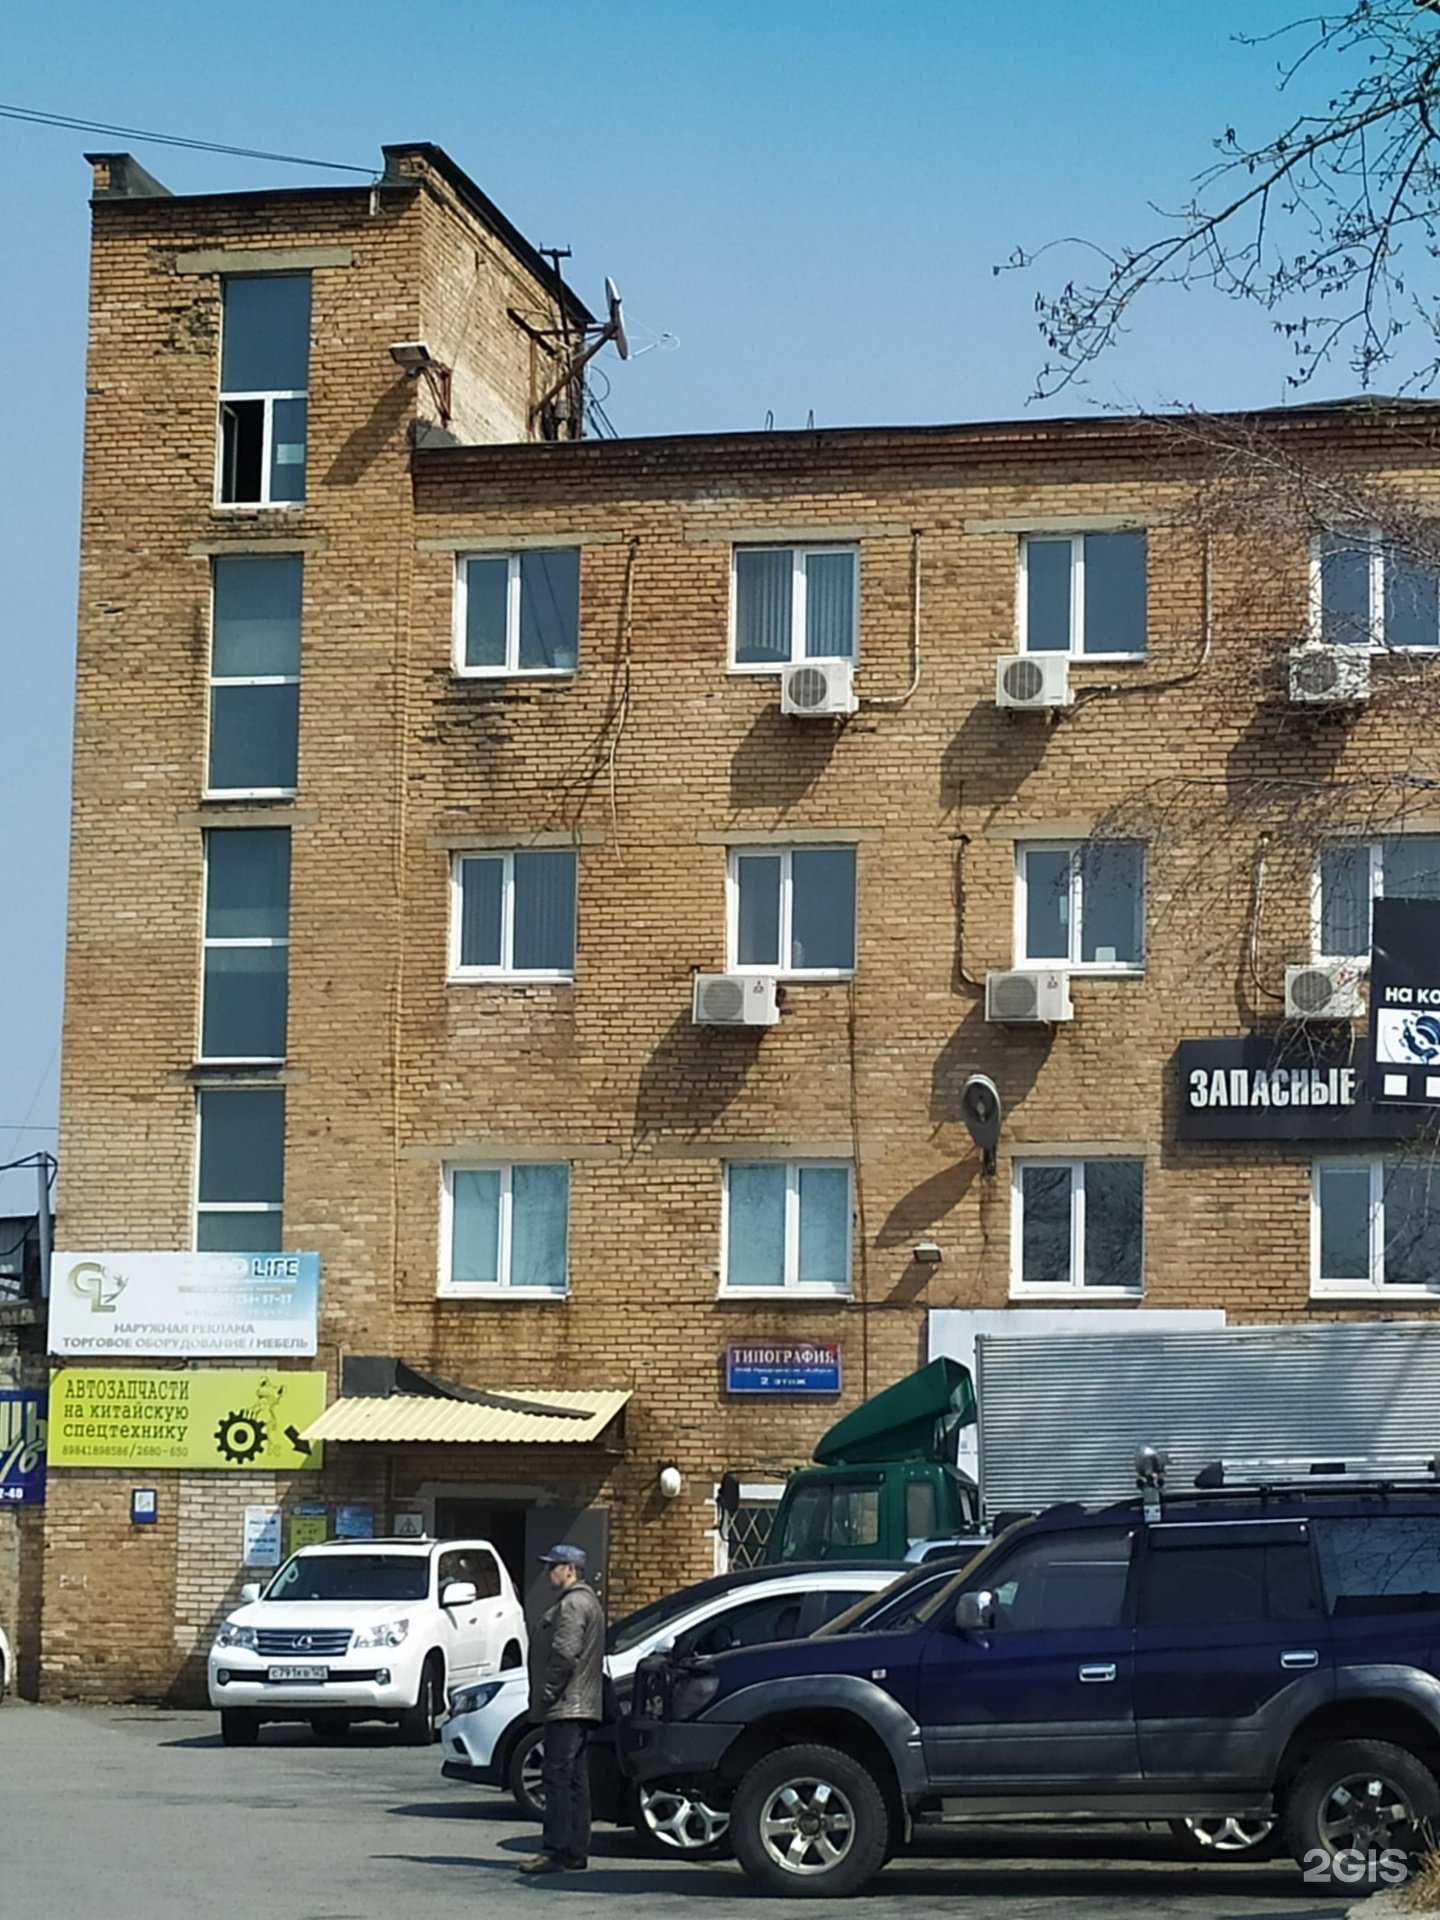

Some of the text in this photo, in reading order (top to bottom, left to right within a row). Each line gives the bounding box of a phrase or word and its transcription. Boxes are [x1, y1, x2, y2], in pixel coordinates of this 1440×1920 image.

[1385, 987, 1413, 1003] на
[1190, 1068, 1356, 1107] ЗАПАСНЫЕ
[253, 1258, 299, 1278] LIFE
[113, 1323, 256, 1335] НАРУЖНАЯ РЕКЛАМА
[62, 1337, 133, 1349] ТОРГОВОЕ
[135, 1338, 246, 1350] ОБОРУДОВАНИЕ
[256, 1338, 309, 1349] МЕБЕЛЬ
[734, 1350, 834, 1363] ТИПОГРАФИЯ
[65, 1379, 190, 1401] АВТОЗАПЧАСТИ
[760, 1377, 769, 1386] 2
[64, 1402, 189, 1422] на китайскую
[63, 1423, 188, 1442] спецтехнику
